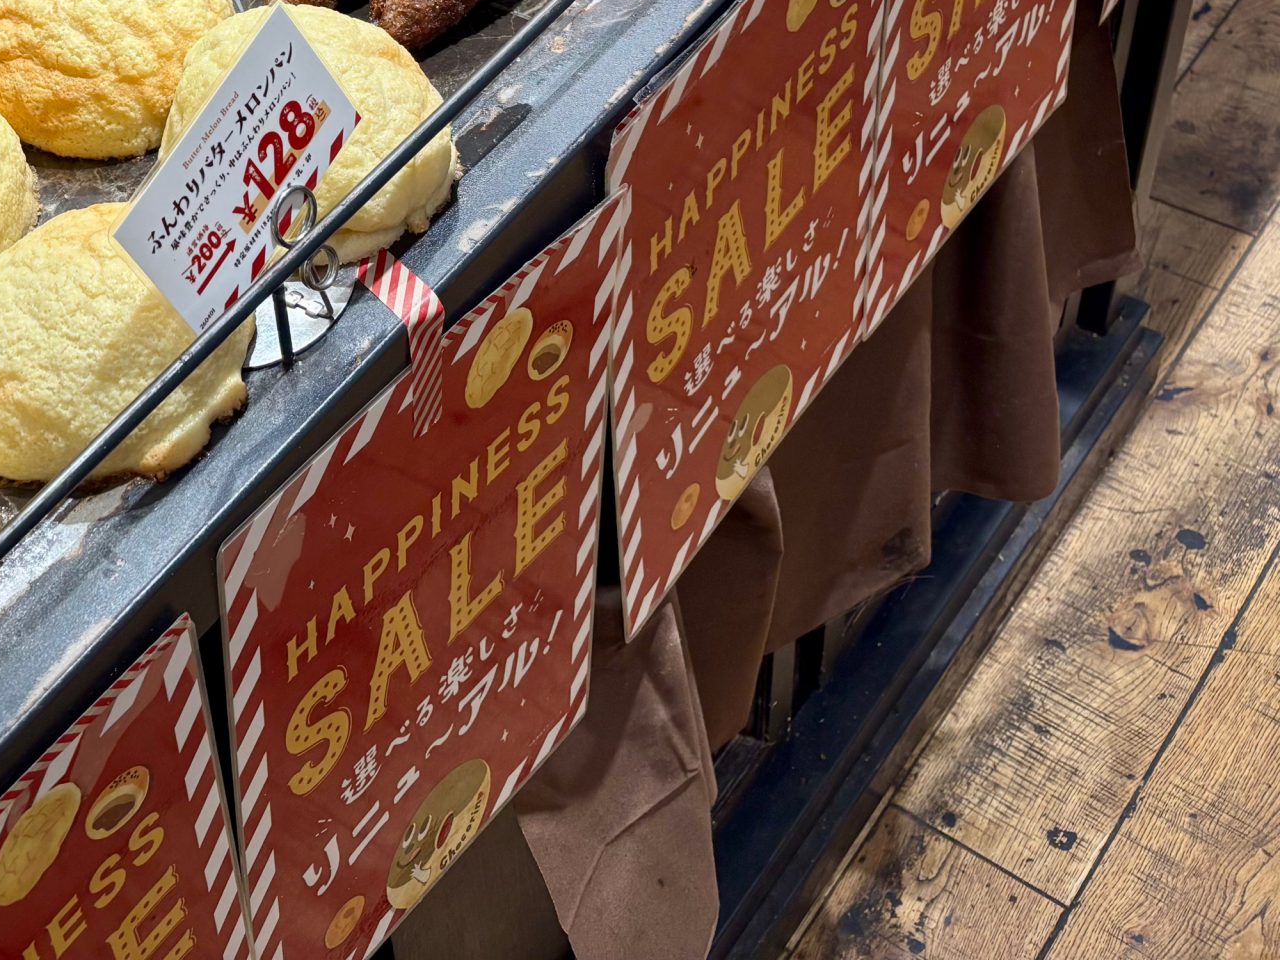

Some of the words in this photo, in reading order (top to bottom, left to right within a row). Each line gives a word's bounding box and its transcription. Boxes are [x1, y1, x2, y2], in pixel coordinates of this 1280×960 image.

[149, 42, 294, 254] ふんわりバターメロンパン
[182, 143, 202, 170] Butter
[201, 117, 222, 144] Melon
[220, 91, 239, 117] Bread
[232, 100, 316, 226] ¥128
[646, 63, 856, 385] SALE
[649, 3, 859, 277] HAPPINESS
[185, 231, 222, 284] ¥200
[683, 218, 821, 398] 選べる楽しさ
[285, 374, 572, 685] HAPPINESS
[285, 437, 570, 797] SALE
[341, 602, 523, 806] 選べる楽しさ
[439, 791, 485, 871] Chocoring
